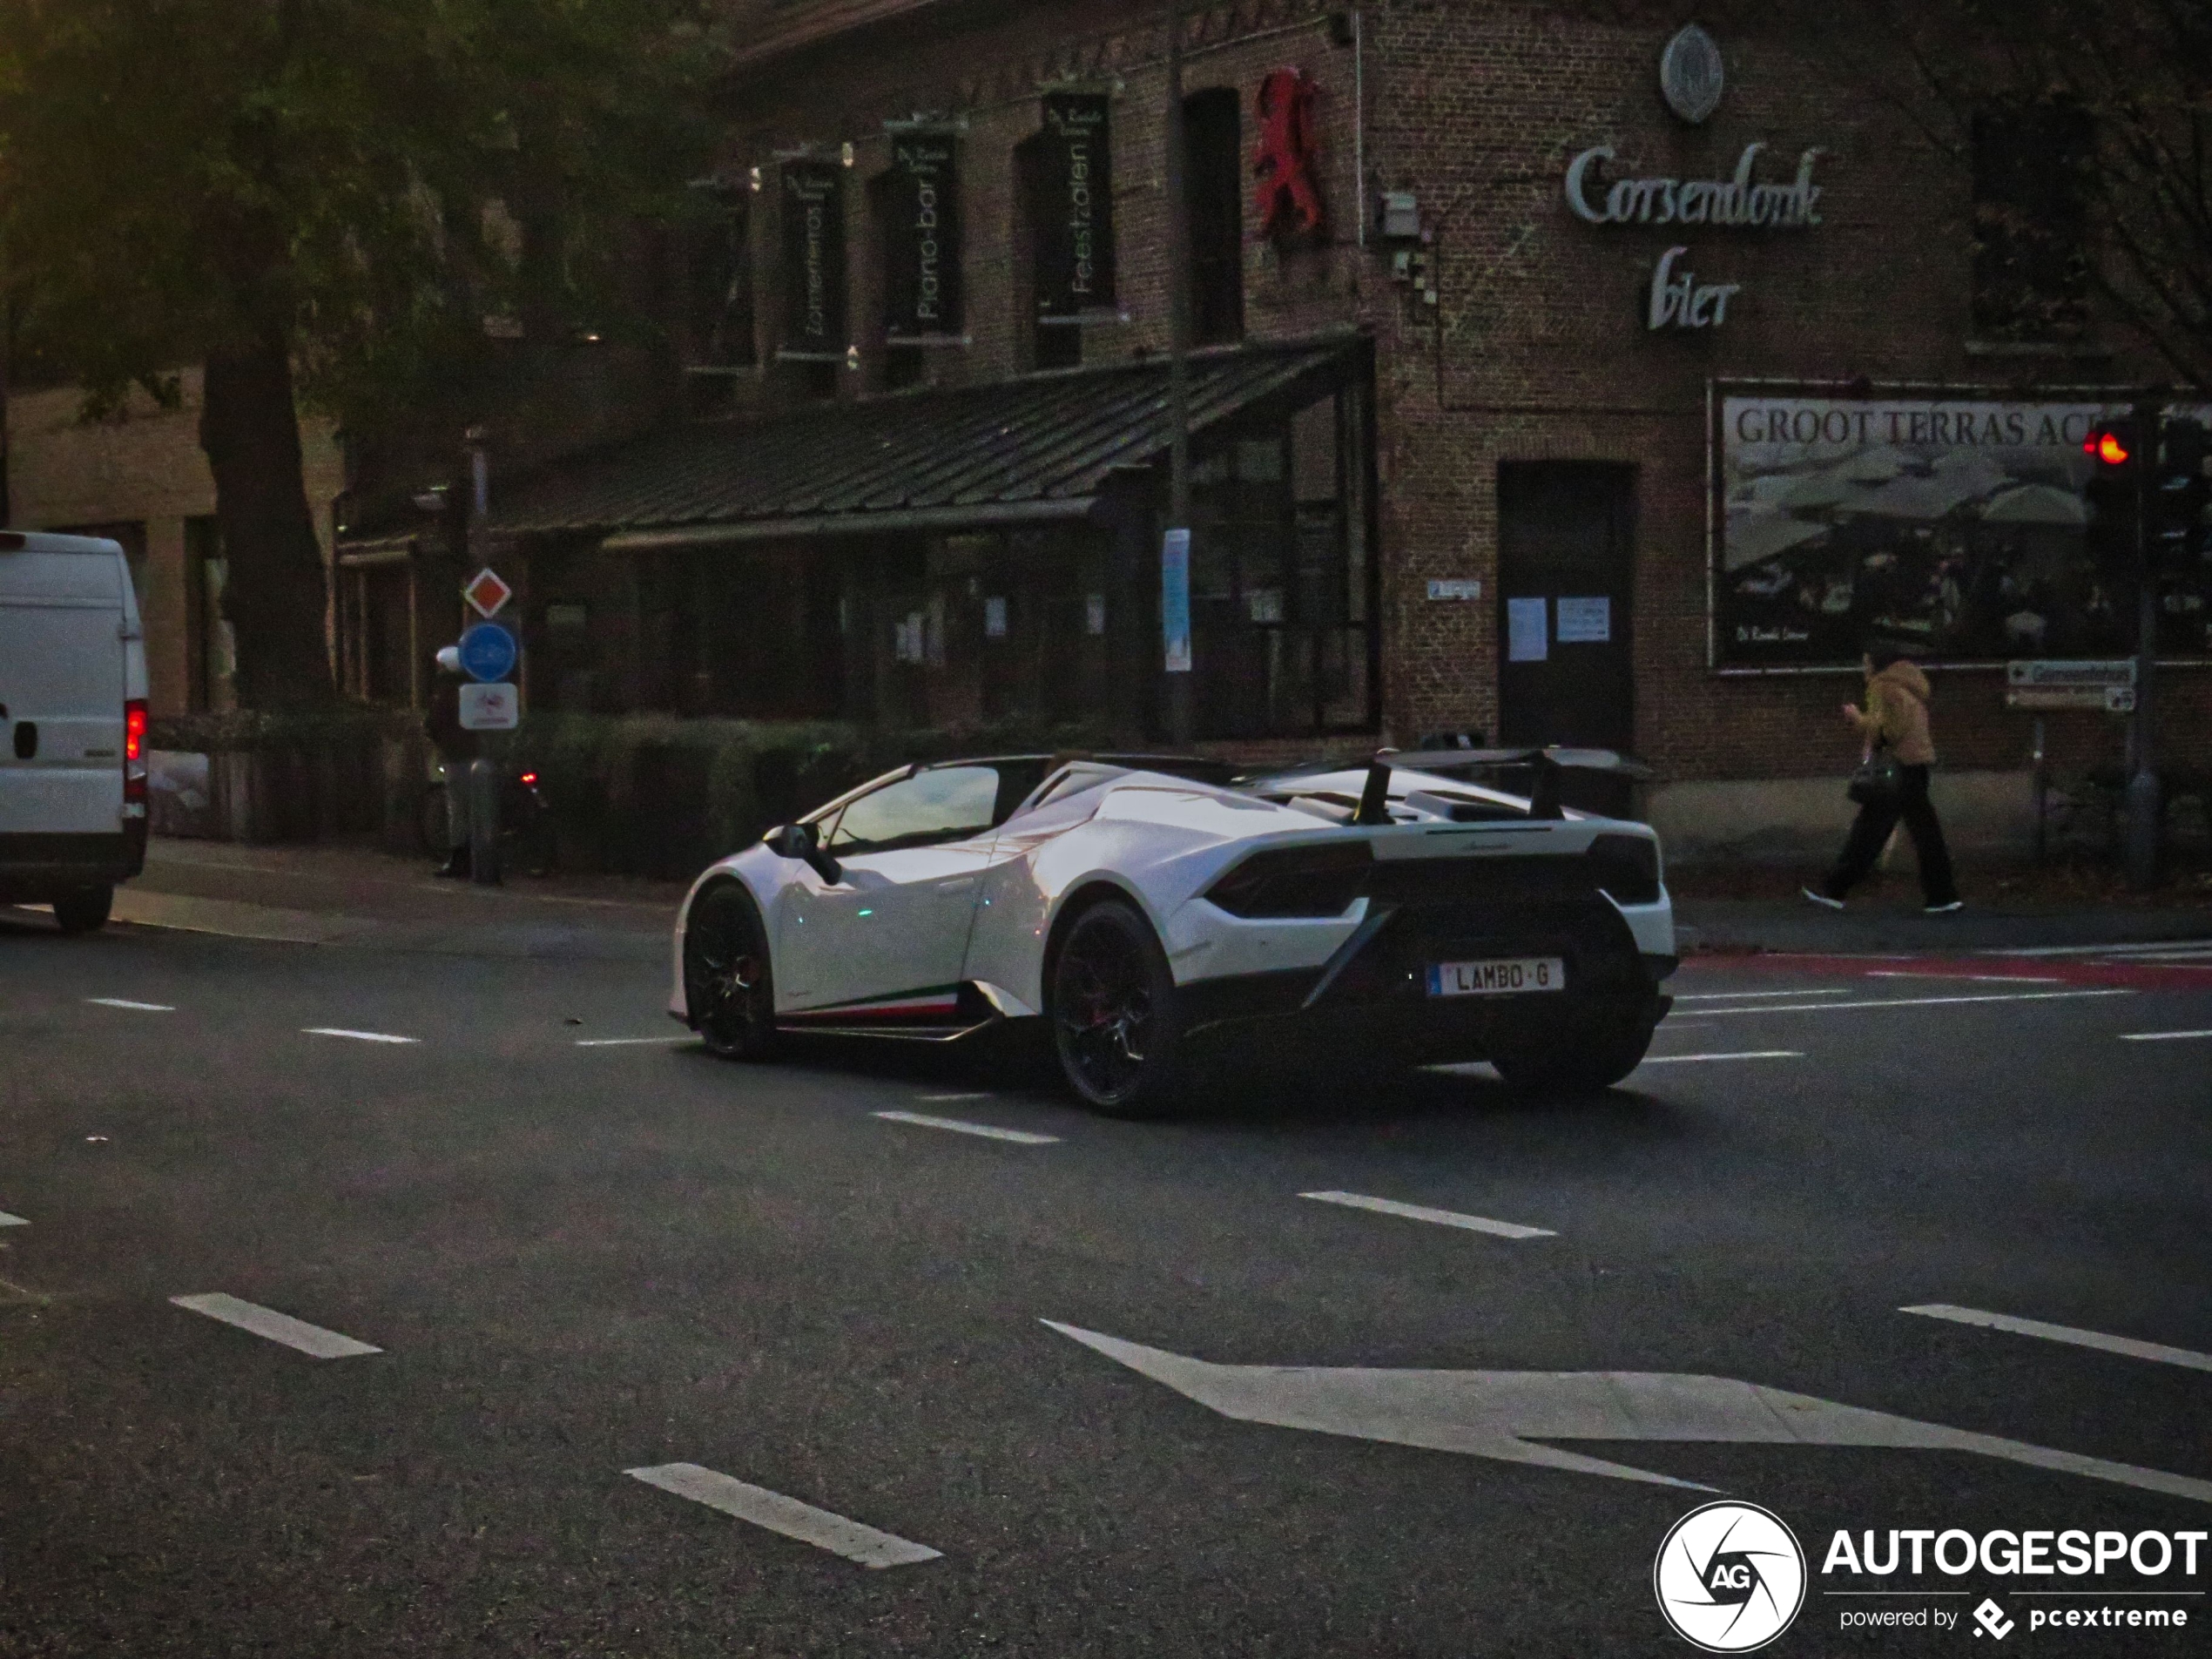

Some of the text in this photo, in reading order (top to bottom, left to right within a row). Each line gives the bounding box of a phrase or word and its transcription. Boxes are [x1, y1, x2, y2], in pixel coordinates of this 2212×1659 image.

[1069, 144, 1093, 293] Feestzalen
[1565, 141, 1827, 225] Corsendonk
[914, 179, 939, 320] Piano-bar
[1648, 245, 1741, 331] bier
[1737, 408, 1874, 445] GROOT
[1882, 410, 2025, 448] TERRAS
